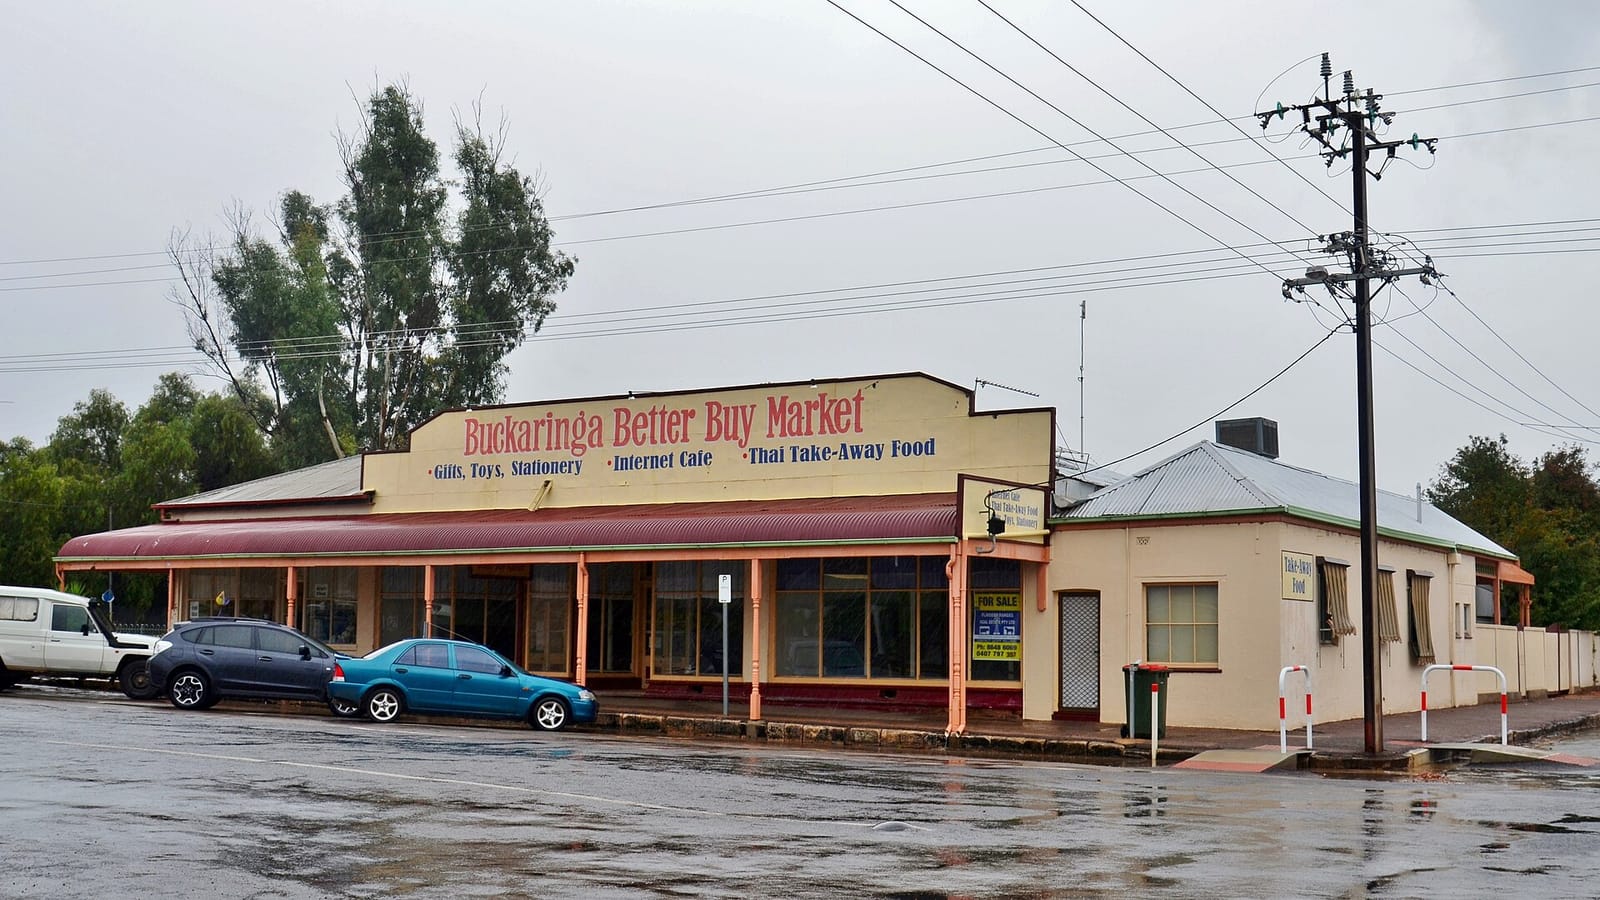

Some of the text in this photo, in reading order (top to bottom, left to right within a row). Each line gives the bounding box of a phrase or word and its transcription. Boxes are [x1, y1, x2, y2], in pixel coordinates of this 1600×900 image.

[464, 389, 865, 457] Buckaringa Better Buy Market
[613, 449, 713, 471] Internet Cafe
[749, 438, 936, 465] Thai Take-Away Food
[434, 459, 583, 480] Gifts, Toys, Stationery
[1027, 506, 1039, 516] Food
[1284, 556, 1312, 577] Take-Away
[1292, 577, 1305, 594] Food
[978, 596, 1018, 607] FOR SALE
